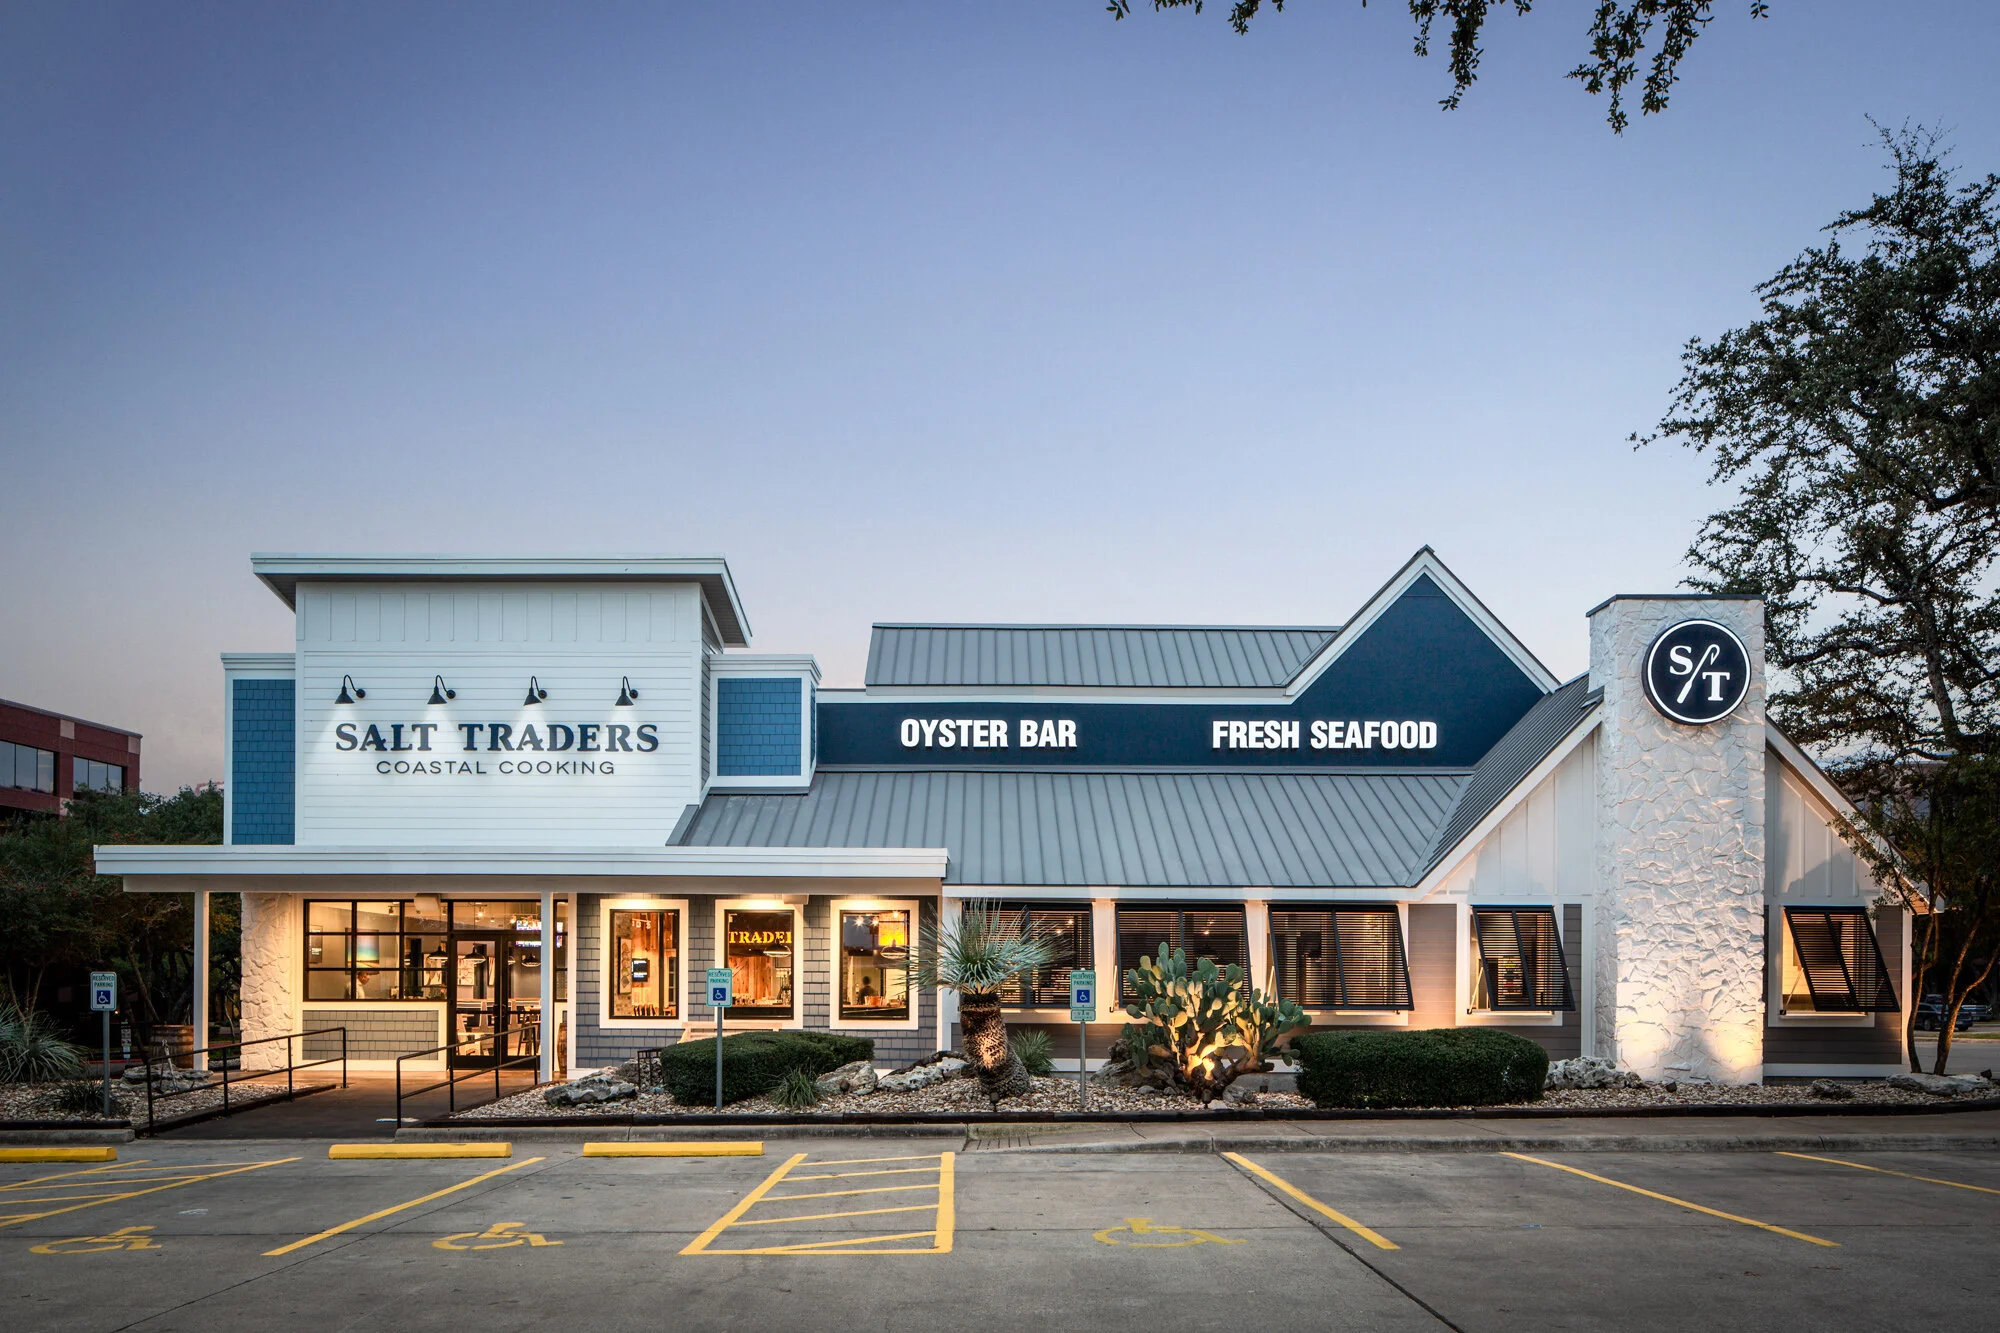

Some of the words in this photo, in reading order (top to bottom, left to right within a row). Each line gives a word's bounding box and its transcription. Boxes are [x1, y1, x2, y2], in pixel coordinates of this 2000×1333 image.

[335, 723, 438, 752] SALT
[458, 723, 660, 753] TRADERS
[900, 719, 1008, 749] OYSTER
[1019, 719, 1078, 749] BAR
[1212, 720, 1300, 749] FRESH
[1309, 720, 1438, 749] SEAFOOD
[376, 761, 487, 775] COASTAL
[499, 761, 615, 775] COOKING
